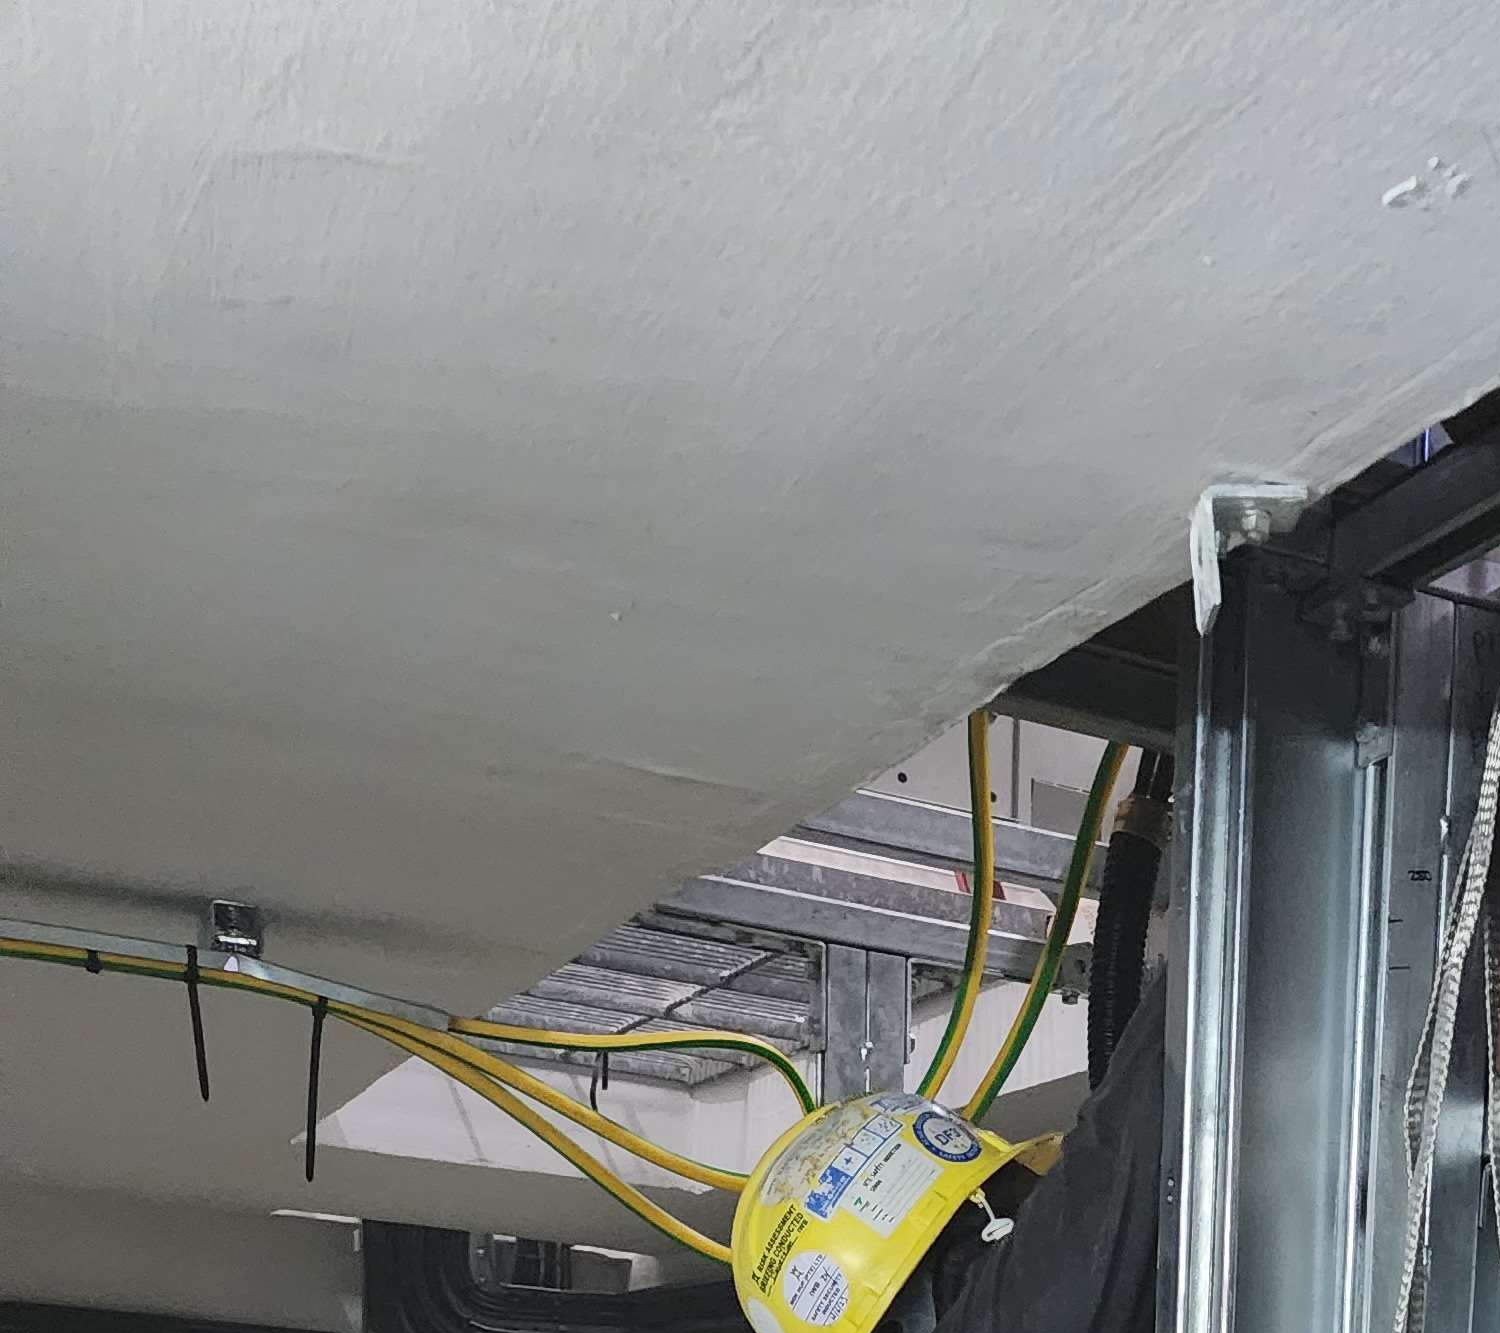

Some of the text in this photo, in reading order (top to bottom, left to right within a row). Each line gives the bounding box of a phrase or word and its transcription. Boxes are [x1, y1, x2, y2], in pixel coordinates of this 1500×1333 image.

[759, 1256, 776, 1293] BRIEFING
[773, 1211, 803, 1257] CONDUCTED
[764, 1203, 796, 1253] ASSESSMENT
